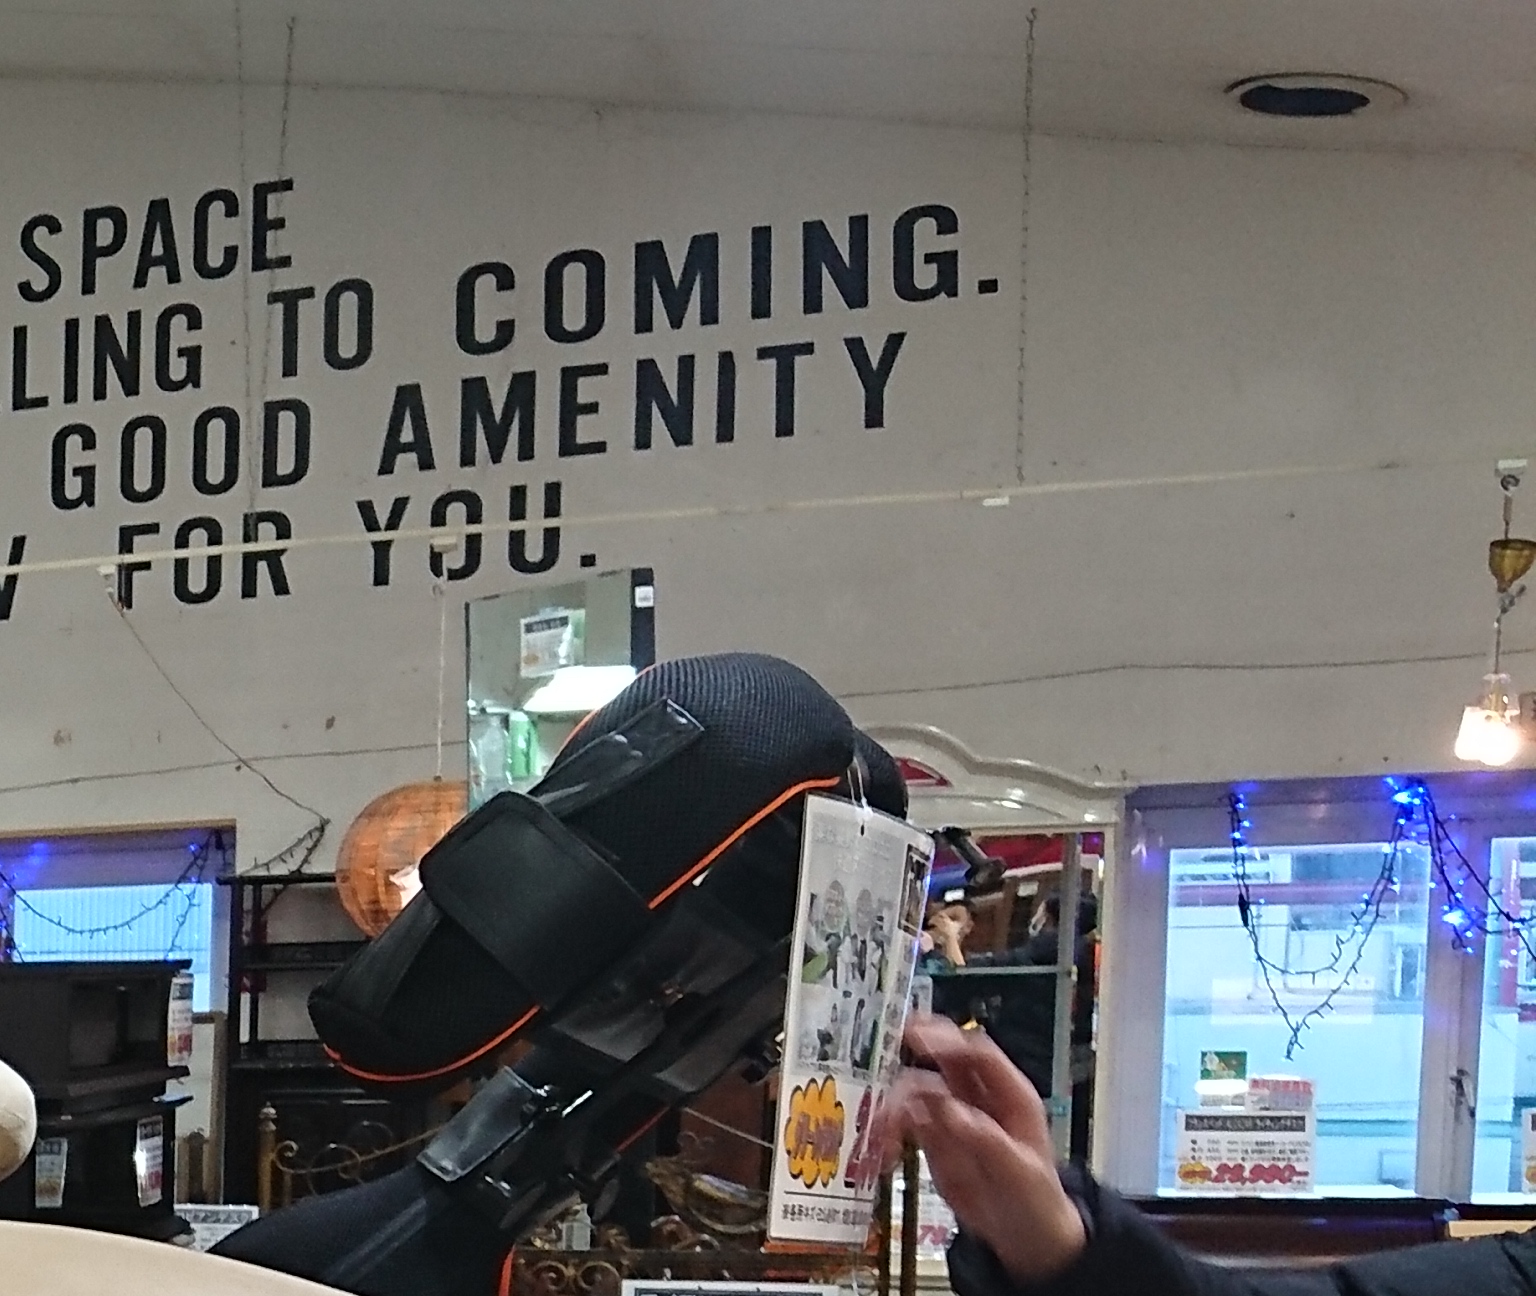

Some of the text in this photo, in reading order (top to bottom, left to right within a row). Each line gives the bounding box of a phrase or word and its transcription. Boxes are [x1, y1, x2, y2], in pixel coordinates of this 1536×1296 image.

[18, 177, 294, 304] SPACE
[267, 278, 373, 379] TO
[456, 204, 998, 357] COMING.
[51, 399, 310, 511] GOOD
[377, 332, 907, 477] AMENITY
[119, 511, 291, 610] FOR
[356, 481, 596, 587] YOU.
